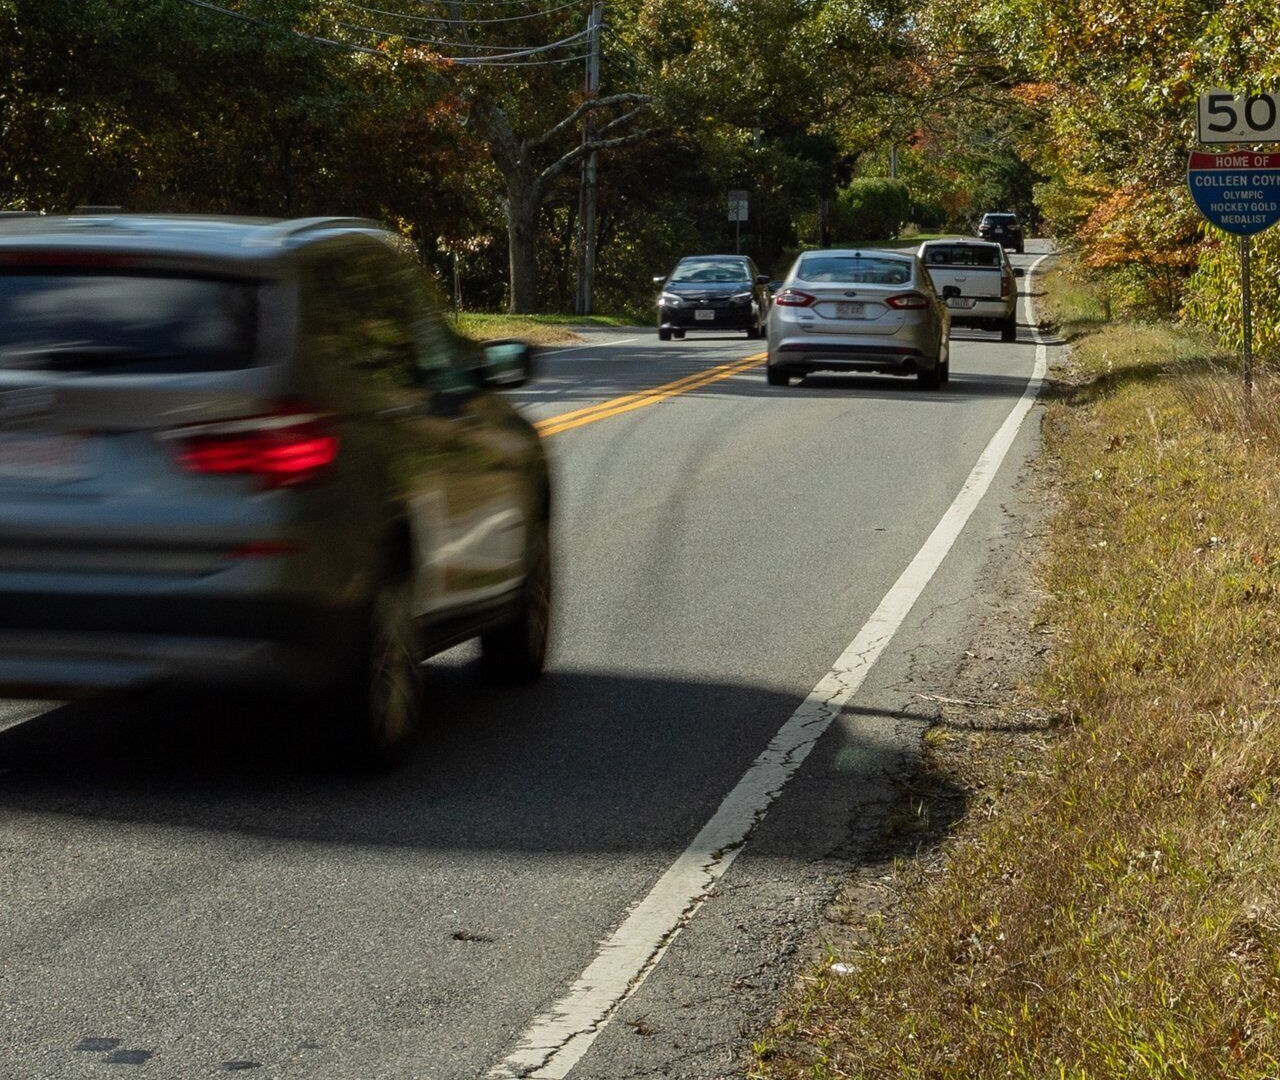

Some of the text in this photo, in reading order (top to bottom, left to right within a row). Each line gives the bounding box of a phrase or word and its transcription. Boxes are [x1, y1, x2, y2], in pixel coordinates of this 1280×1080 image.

[1207, 93, 1276, 133] 50
[1216, 156, 1270, 167] HOME OF
[1195, 176, 1248, 187] COLLEEN
[1223, 190, 1264, 199] OLYMPIC
[1210, 202, 1277, 212] HOCKEY GOLD
[1221, 214, 1267, 223] MEDALIST
